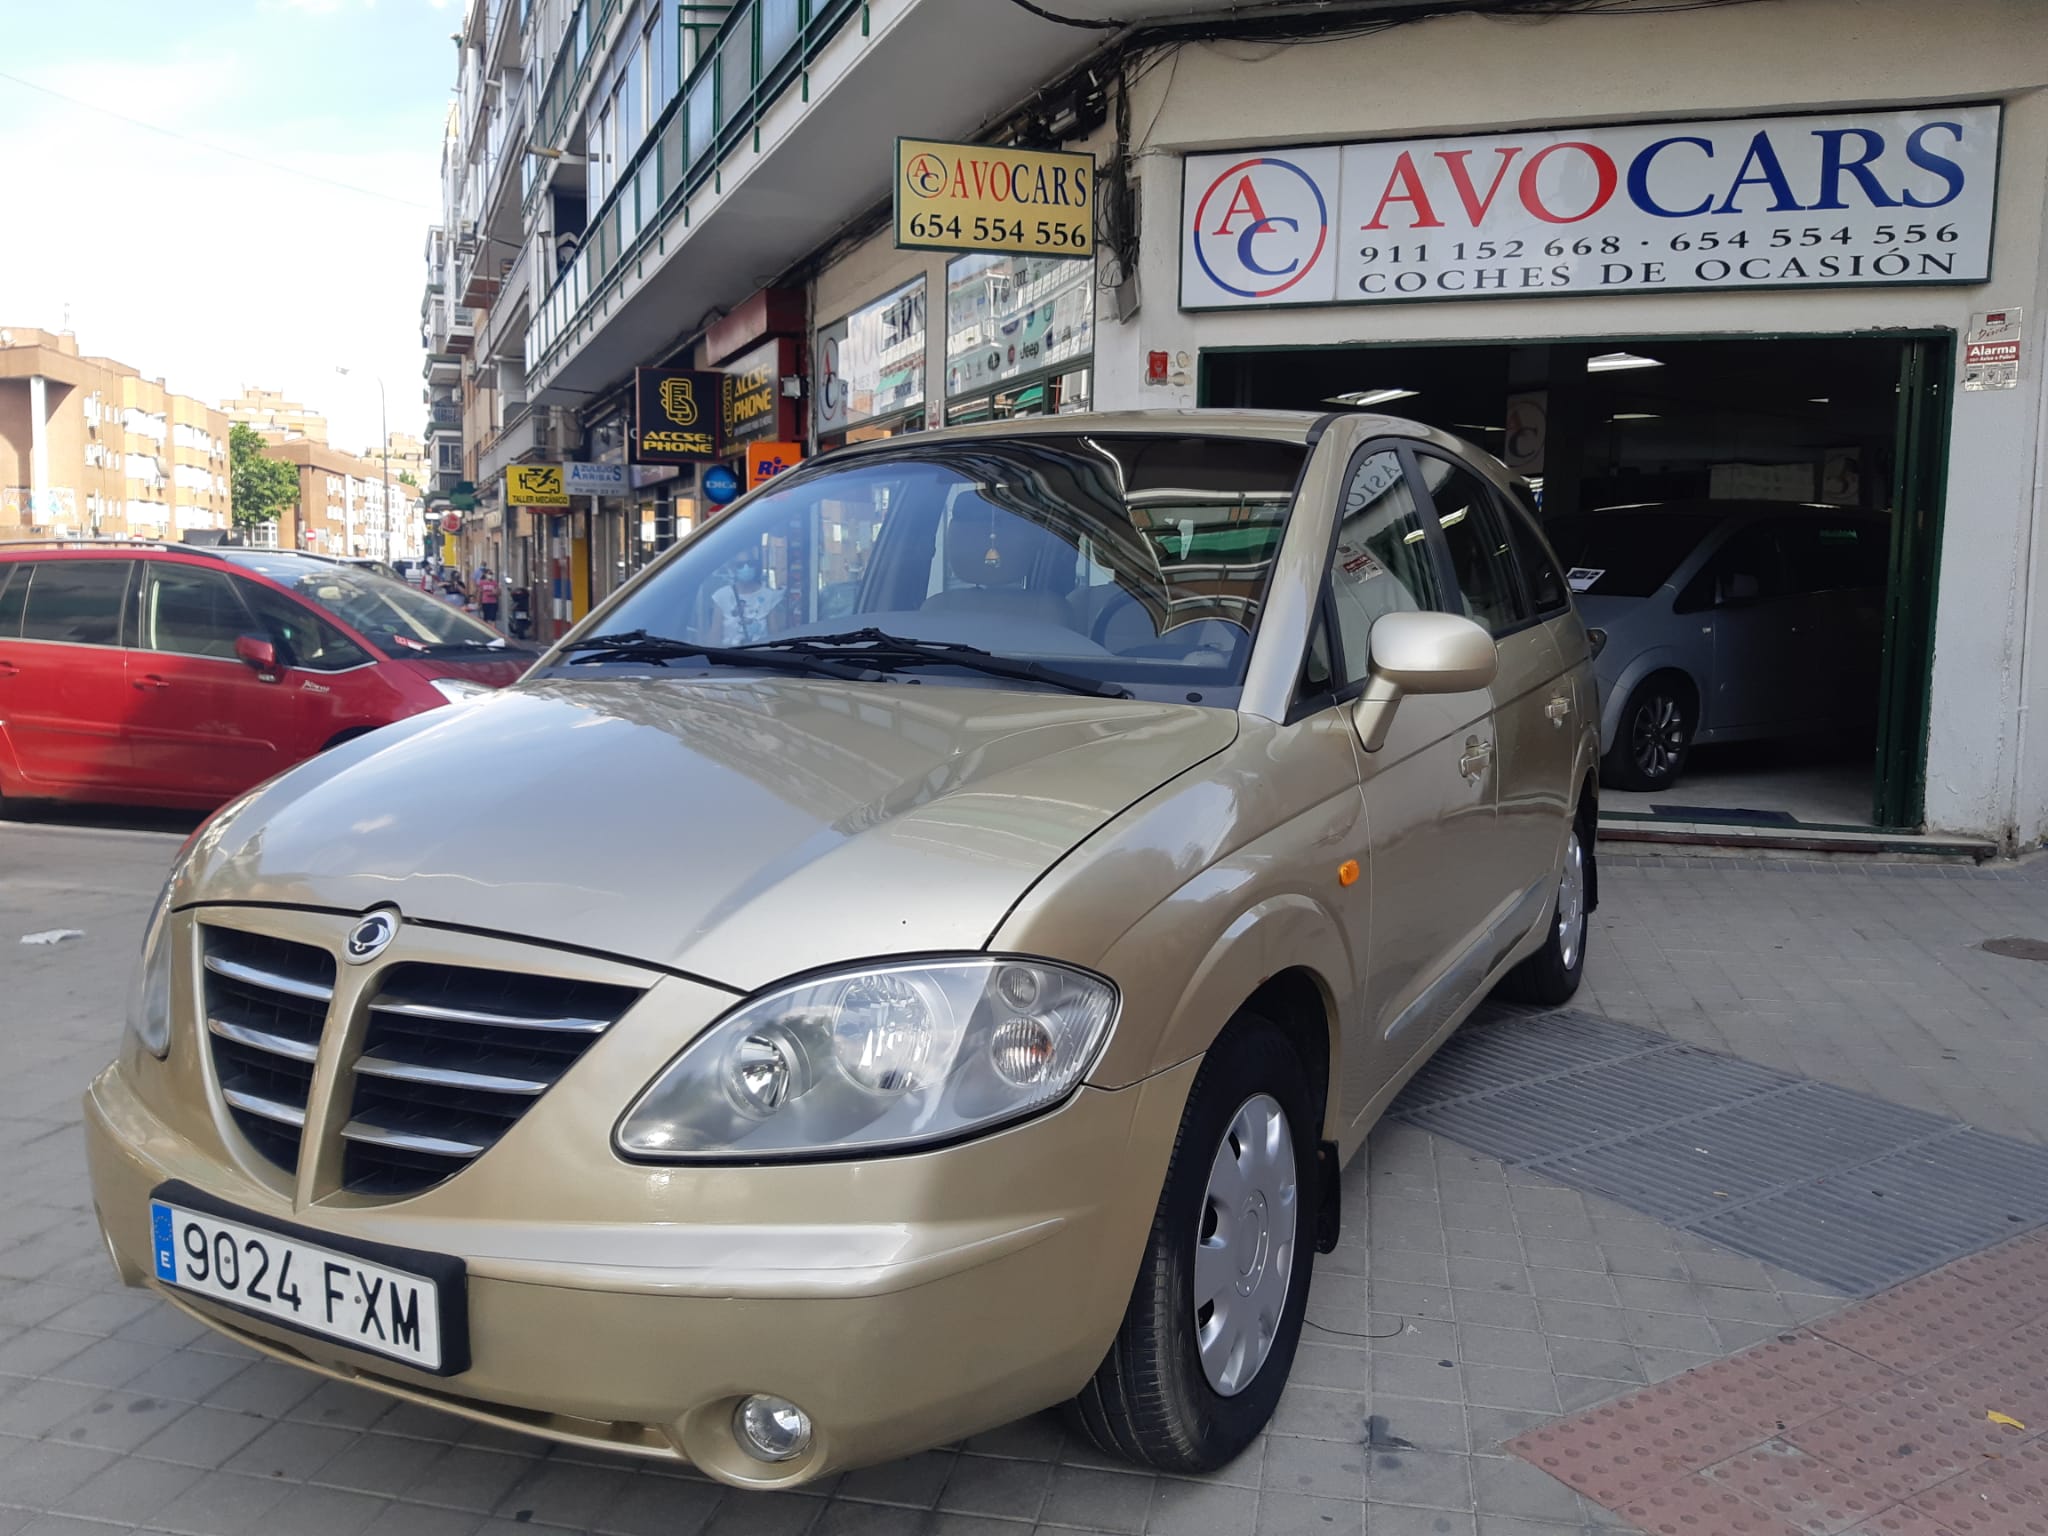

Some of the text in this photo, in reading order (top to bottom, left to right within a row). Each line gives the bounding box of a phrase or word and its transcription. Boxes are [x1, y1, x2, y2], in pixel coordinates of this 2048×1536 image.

[950, 157, 1087, 208] AVOCARS
[1360, 121, 1965, 231] AVOCARS
[910, 212, 1087, 248] 654 554 556
[1360, 222, 1960, 265] 911 152 668 654 554 556
[1358, 247, 1958, 294] COCHES DE OCASIÓN
[1021, 341, 1040, 360] Jeep
[1970, 344, 2017, 357] Alarma
[734, 387, 772, 423] PHONE
[643, 440, 713, 454] PHONE
[512, 495, 536, 504] TALLER
[706, 480, 737, 489] DIGI
[160, 1251, 171, 1269] E
[183, 1222, 422, 1353] 9024 FXM
